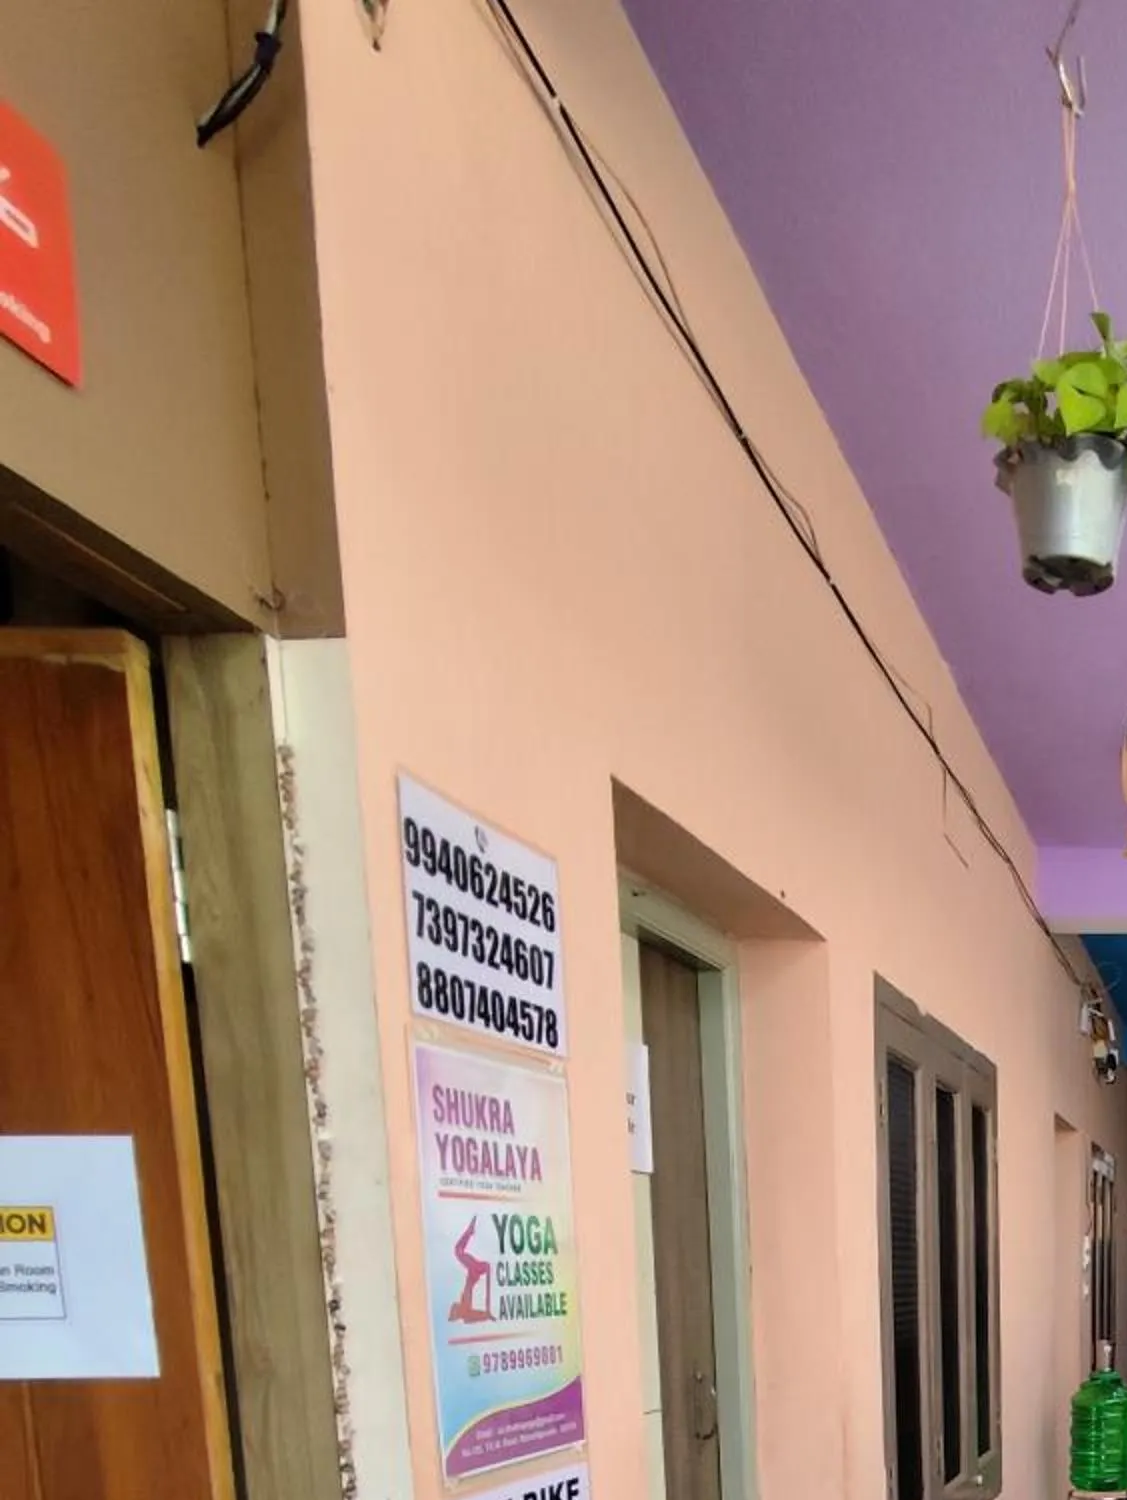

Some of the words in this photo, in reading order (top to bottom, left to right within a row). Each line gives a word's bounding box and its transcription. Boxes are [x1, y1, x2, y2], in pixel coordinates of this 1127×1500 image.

[404, 817, 556, 933] 9940624526
[412, 889, 554, 990] 7397324607
[416, 961, 558, 1048] 8807404578
[432, 1084, 515, 1135] SHUKRA
[435, 1132, 542, 1181] YOGALAYA
[492, 1213, 558, 1255] YOGA
[496, 1260, 554, 1287] CLASSES
[499, 1292, 568, 1321] AVAILABLE
